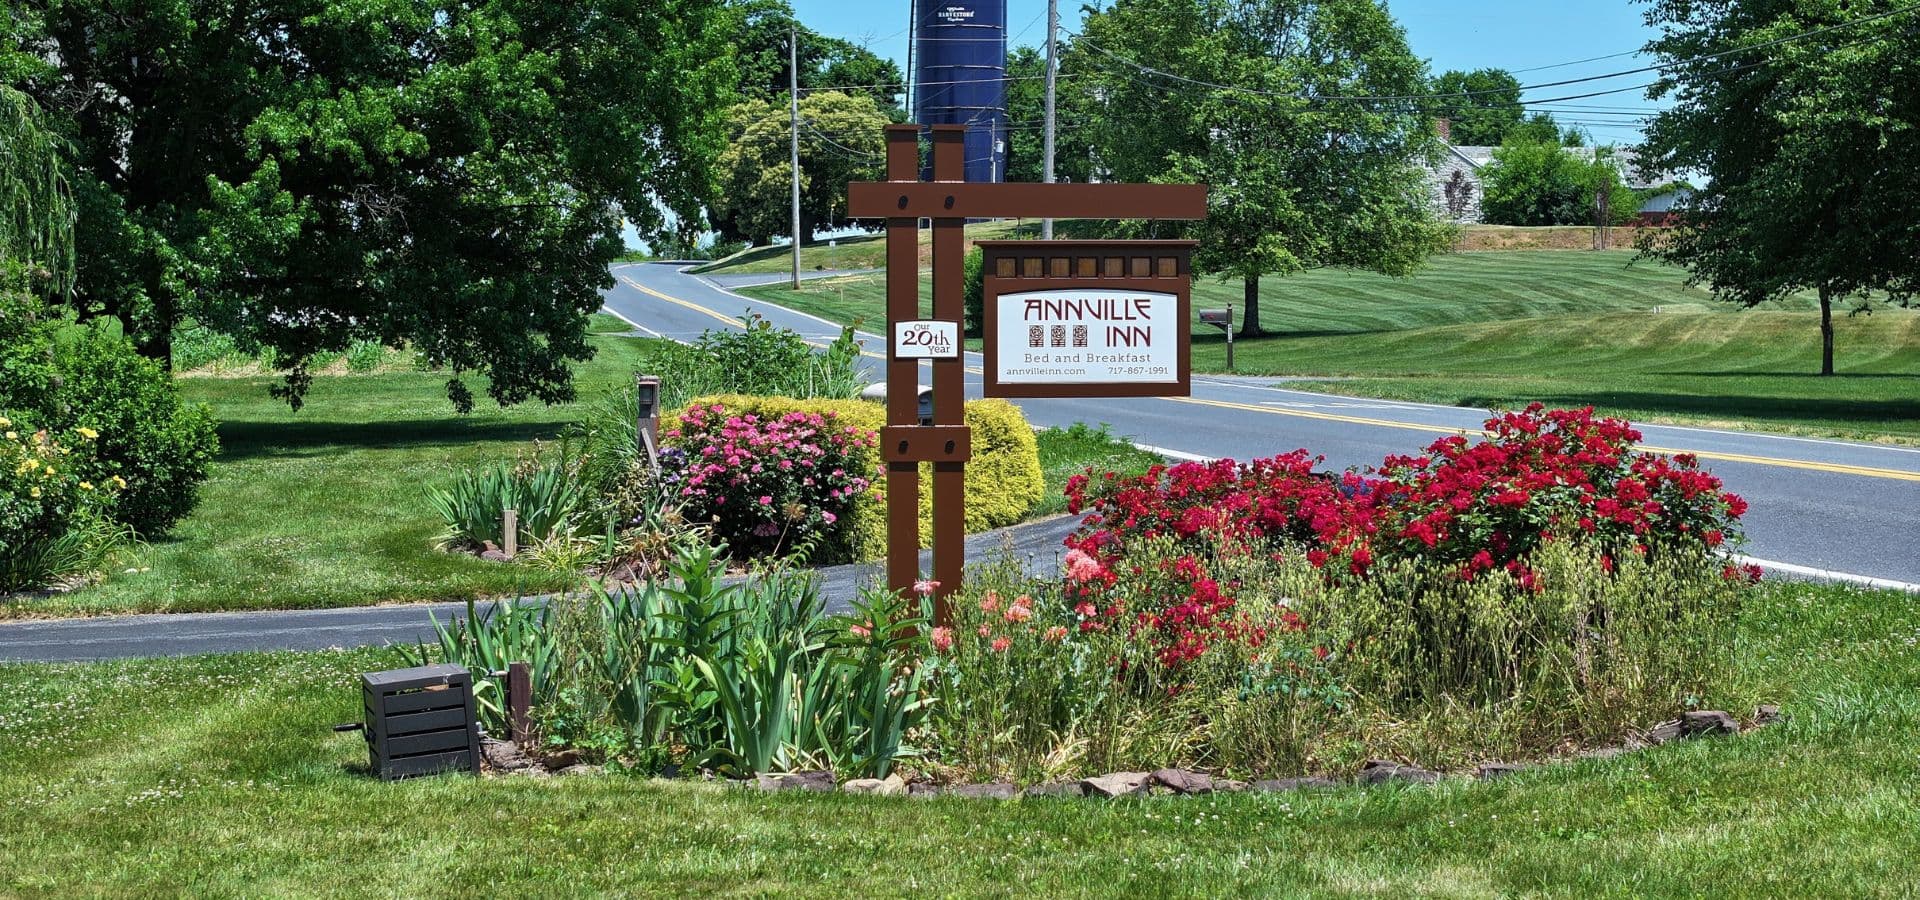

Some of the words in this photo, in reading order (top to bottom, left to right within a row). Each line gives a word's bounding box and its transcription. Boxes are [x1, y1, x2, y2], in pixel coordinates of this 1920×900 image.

[1024, 299, 1151, 321] ANNVILLE
[913, 323, 930, 331] Our
[902, 329, 951, 346] 20th
[1106, 326, 1151, 347] INN
[927, 346, 951, 355] Year
[1024, 353, 1050, 363] Bed
[1054, 353, 1080, 363] and
[1086, 353, 1151, 363] Breakfast
[1006, 366, 1086, 375] annvilleinn.com
[1108, 366, 1169, 375] 717-867-1991
